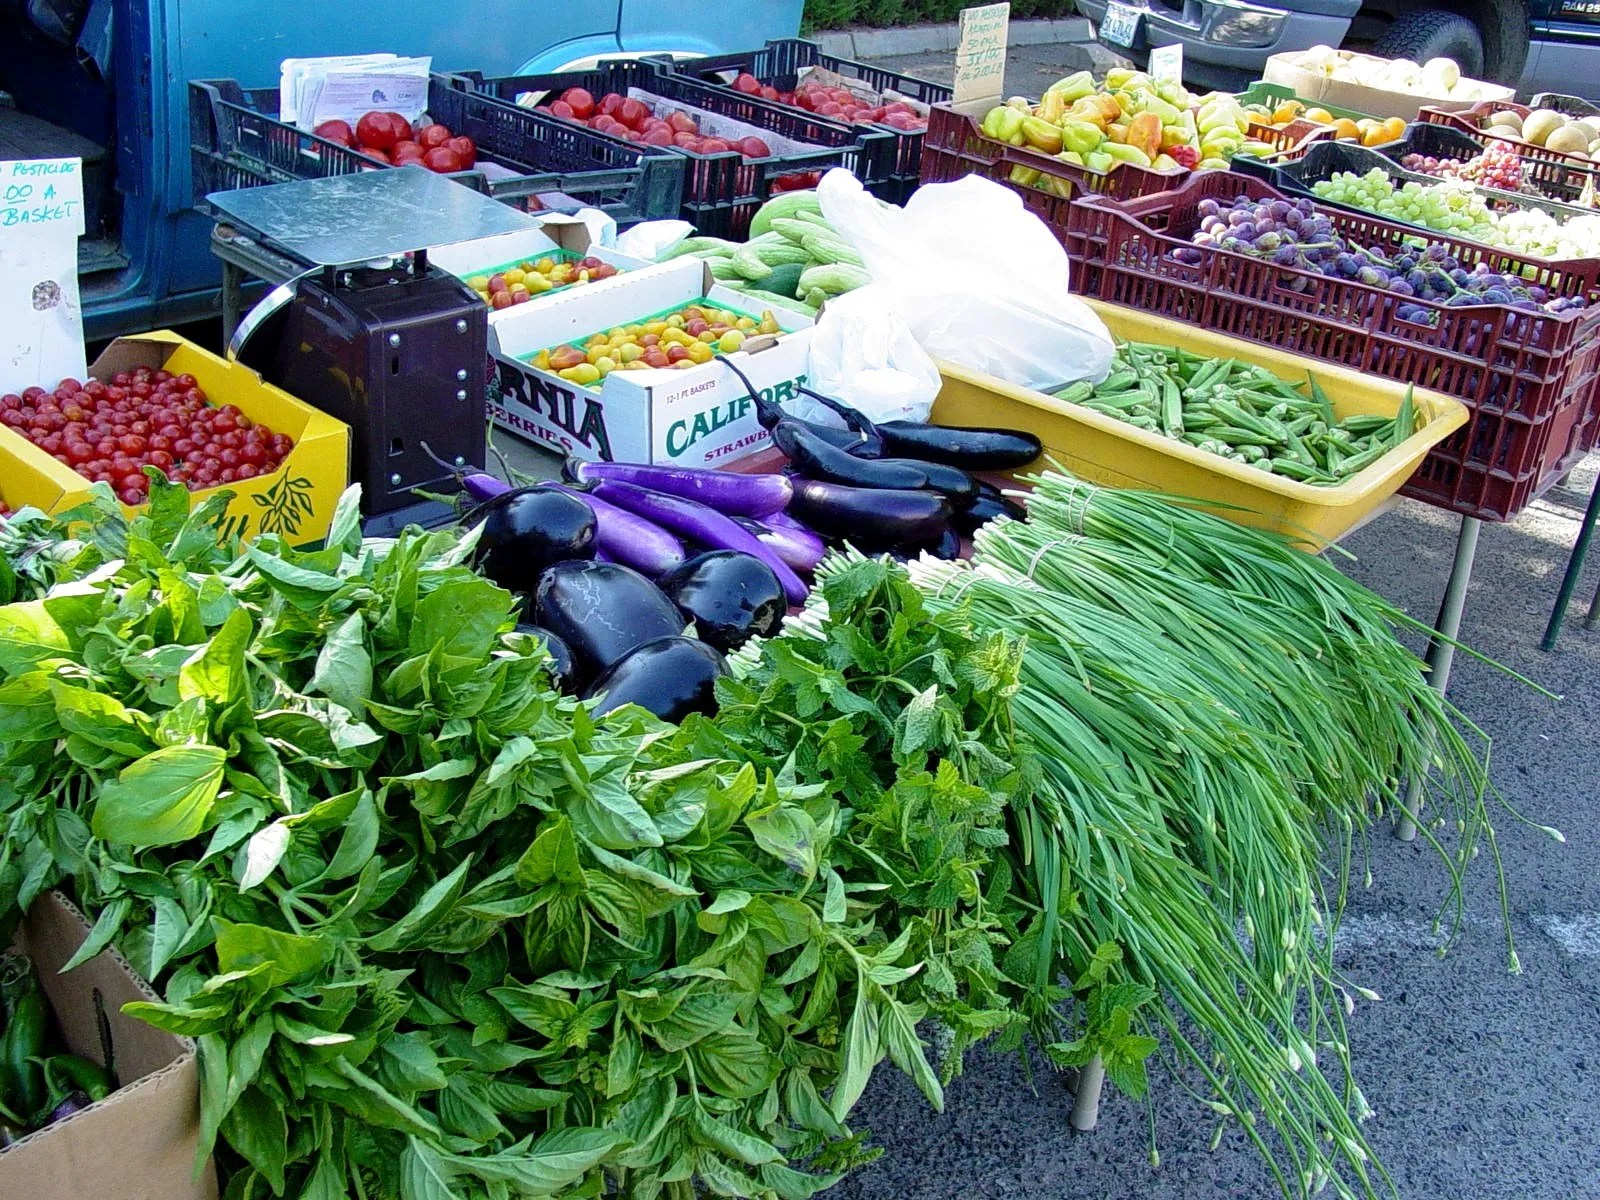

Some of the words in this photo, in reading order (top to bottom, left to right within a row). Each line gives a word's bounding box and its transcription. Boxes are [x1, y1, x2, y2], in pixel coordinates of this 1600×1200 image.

[1562, 2, 1585, 12] RAM
[0, 201, 79, 226] BASKET
[689, 379, 716, 397] BASKETS
